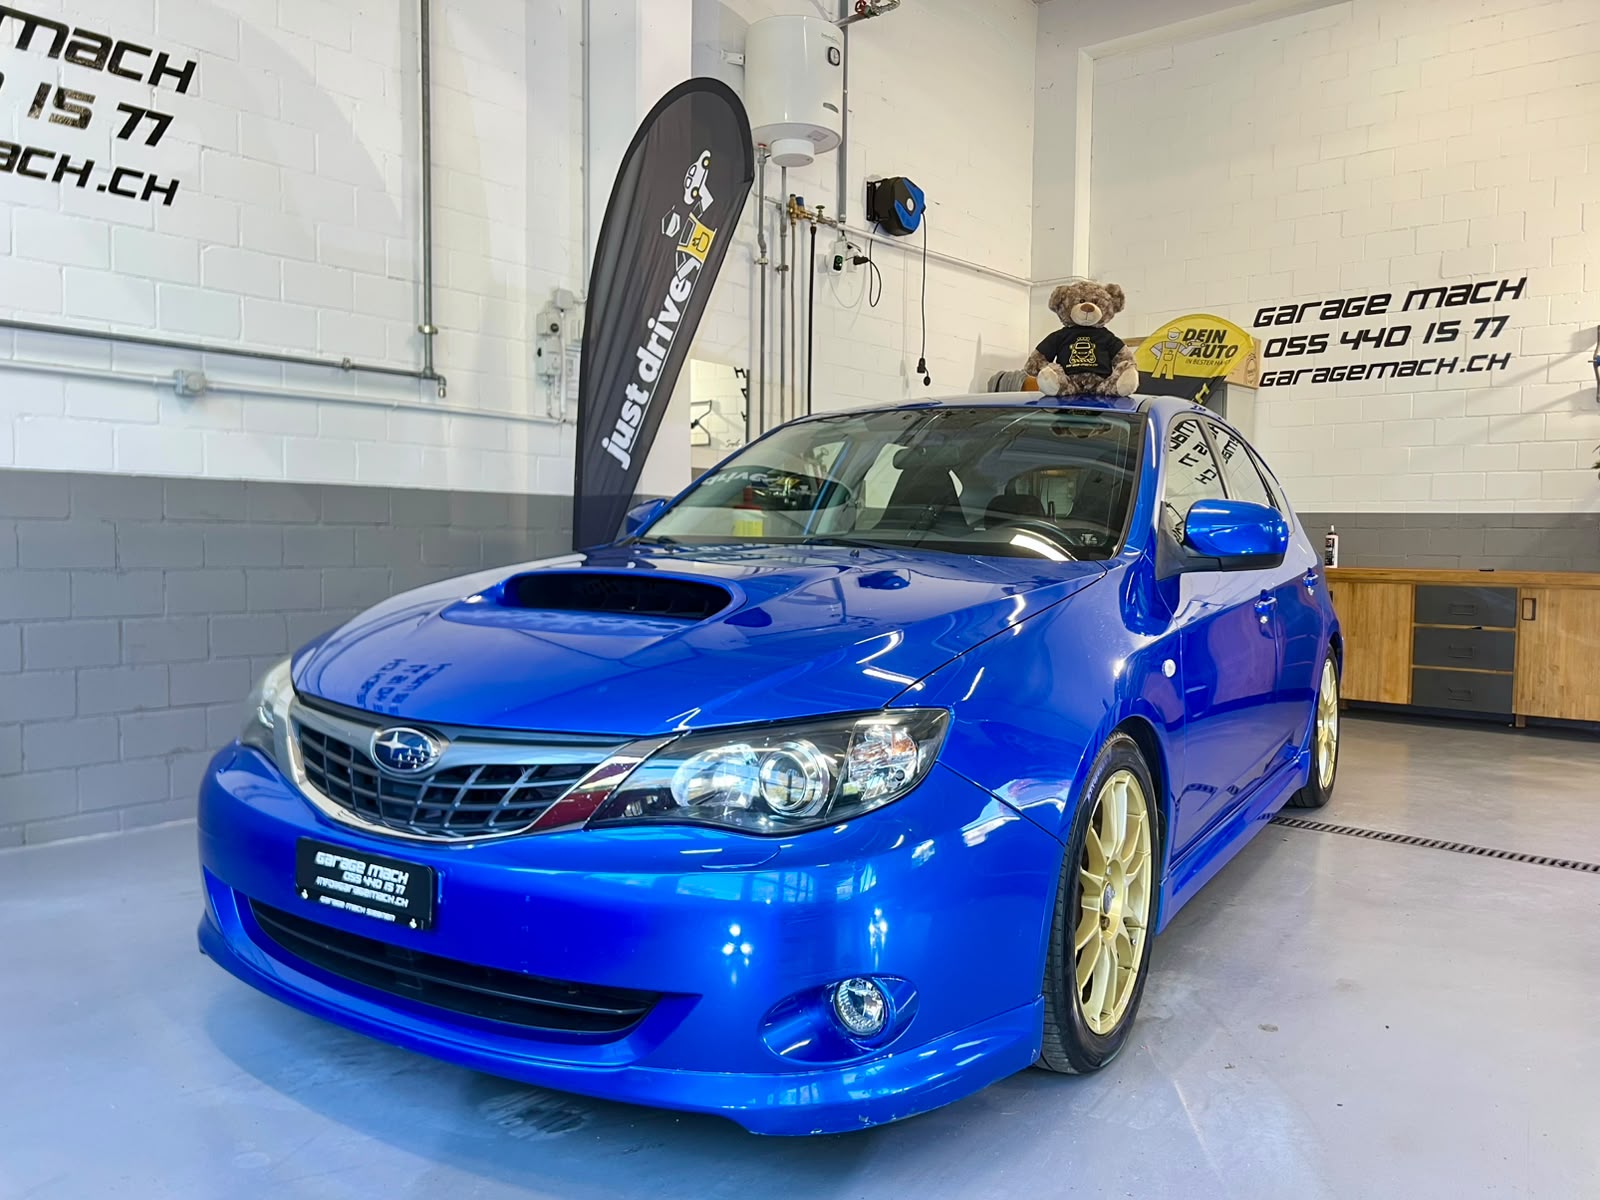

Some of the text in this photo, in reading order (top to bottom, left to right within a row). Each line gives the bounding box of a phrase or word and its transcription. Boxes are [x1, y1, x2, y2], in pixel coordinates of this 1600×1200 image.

[27, 82, 174, 147] 15 77
[1182, 328, 1227, 344] DEIN
[1189, 344, 1239, 359] AUTO
[1263, 315, 1510, 358] 055 440 15 77
[601, 277, 693, 471] just drive
